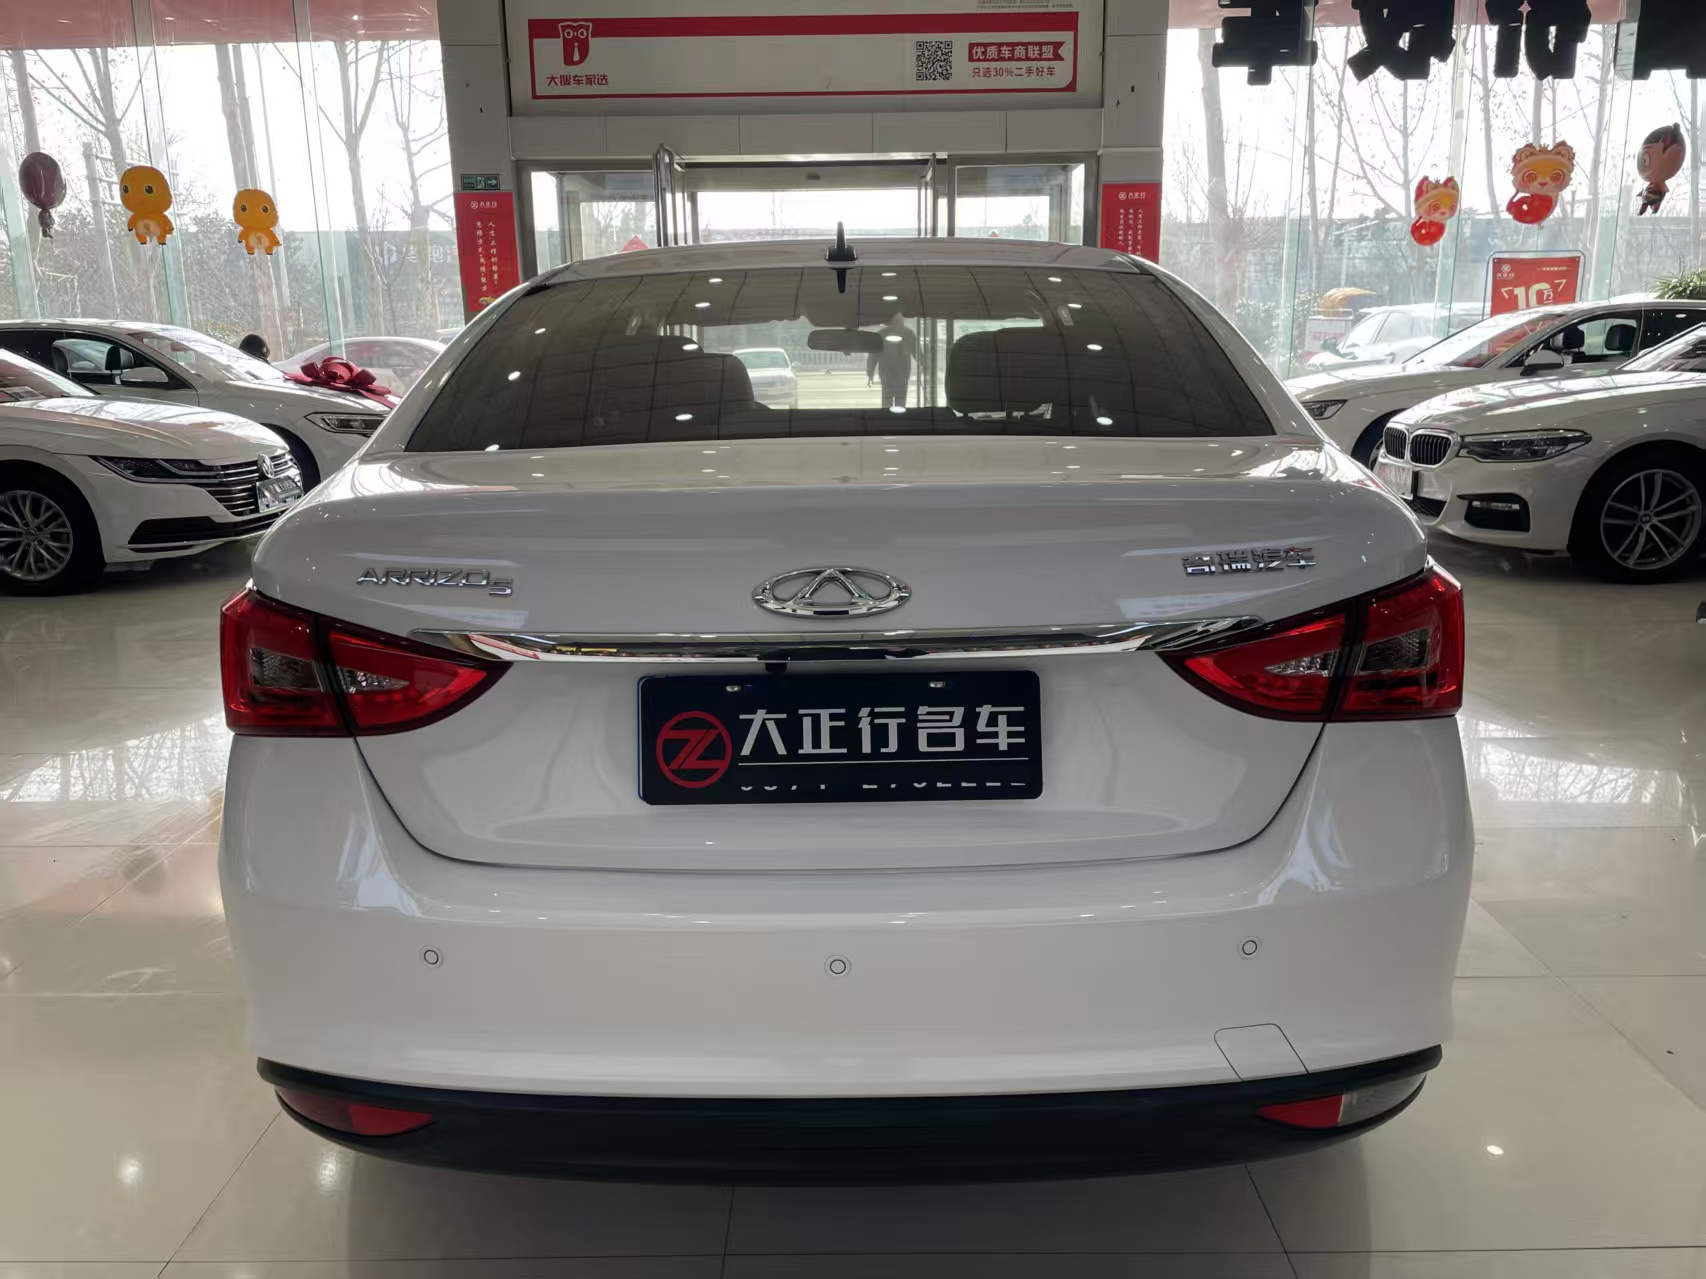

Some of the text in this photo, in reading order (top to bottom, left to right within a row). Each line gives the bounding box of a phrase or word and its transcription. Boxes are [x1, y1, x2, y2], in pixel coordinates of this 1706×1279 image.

[972, 45, 1055, 60] 优质车商联盟
[972, 66, 1056, 79] 只选30%二手好车
[546, 74, 609, 87] 大搜车家选
[356, 567, 491, 587] ARRIZO
[738, 704, 1026, 756] 大正行名车
